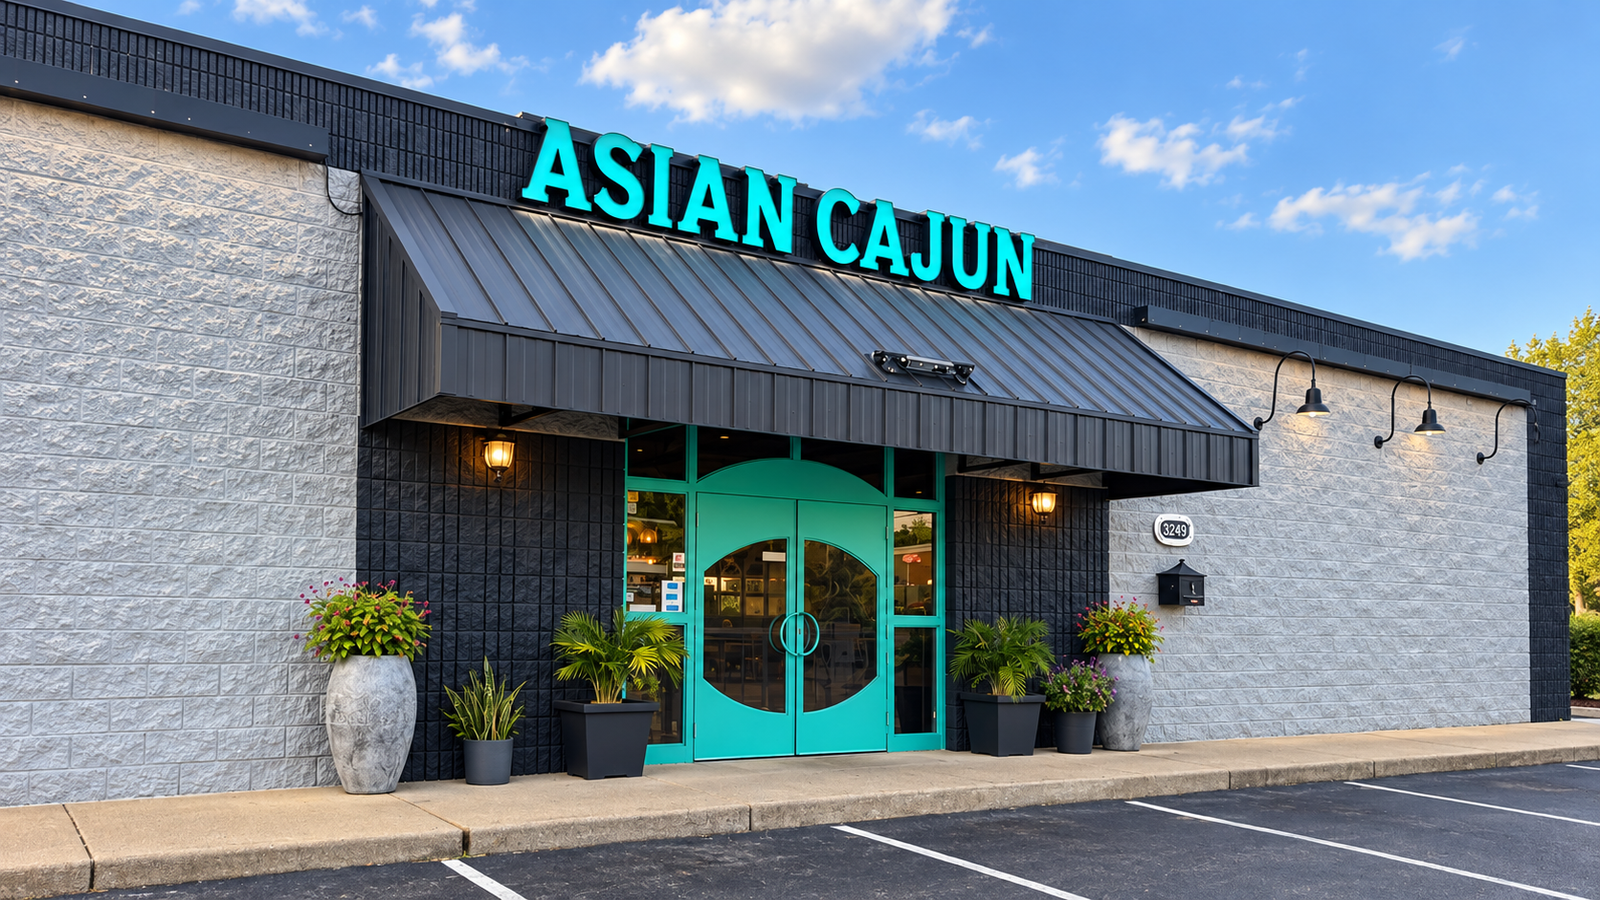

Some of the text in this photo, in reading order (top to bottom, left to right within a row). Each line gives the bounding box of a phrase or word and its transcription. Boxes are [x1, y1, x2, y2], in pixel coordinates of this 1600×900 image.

[521, 117, 1035, 301] ASIAN CAJUN
[1163, 523, 1187, 537] 3249
